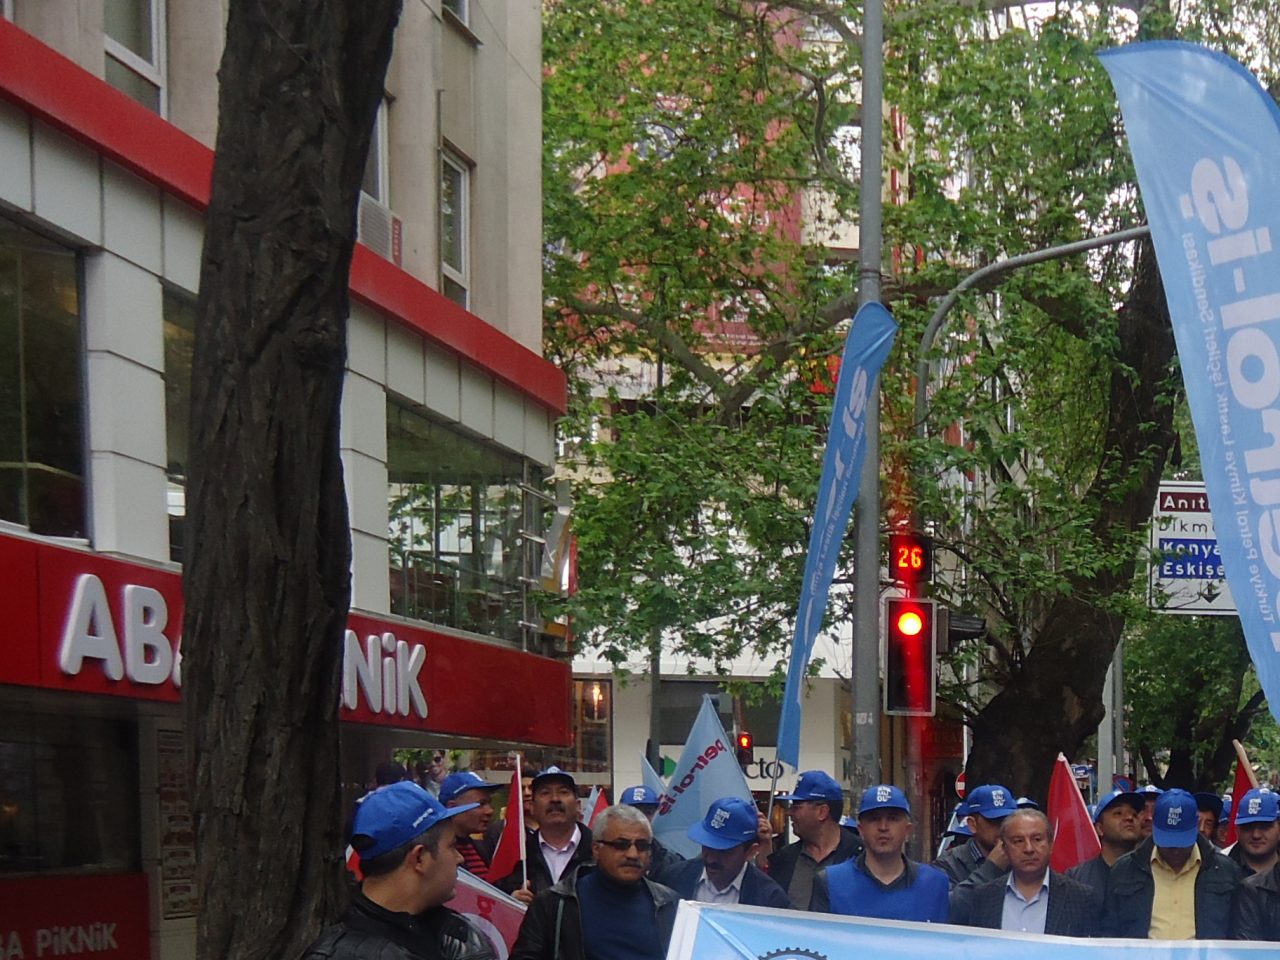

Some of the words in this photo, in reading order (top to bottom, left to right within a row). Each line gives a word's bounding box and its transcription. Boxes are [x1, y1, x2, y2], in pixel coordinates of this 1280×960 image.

[1163, 494, 1211, 510] Anıt
[1159, 518, 1215, 532] Dikm
[898, 547, 922, 568] 26
[60, 573, 184, 689] AB
